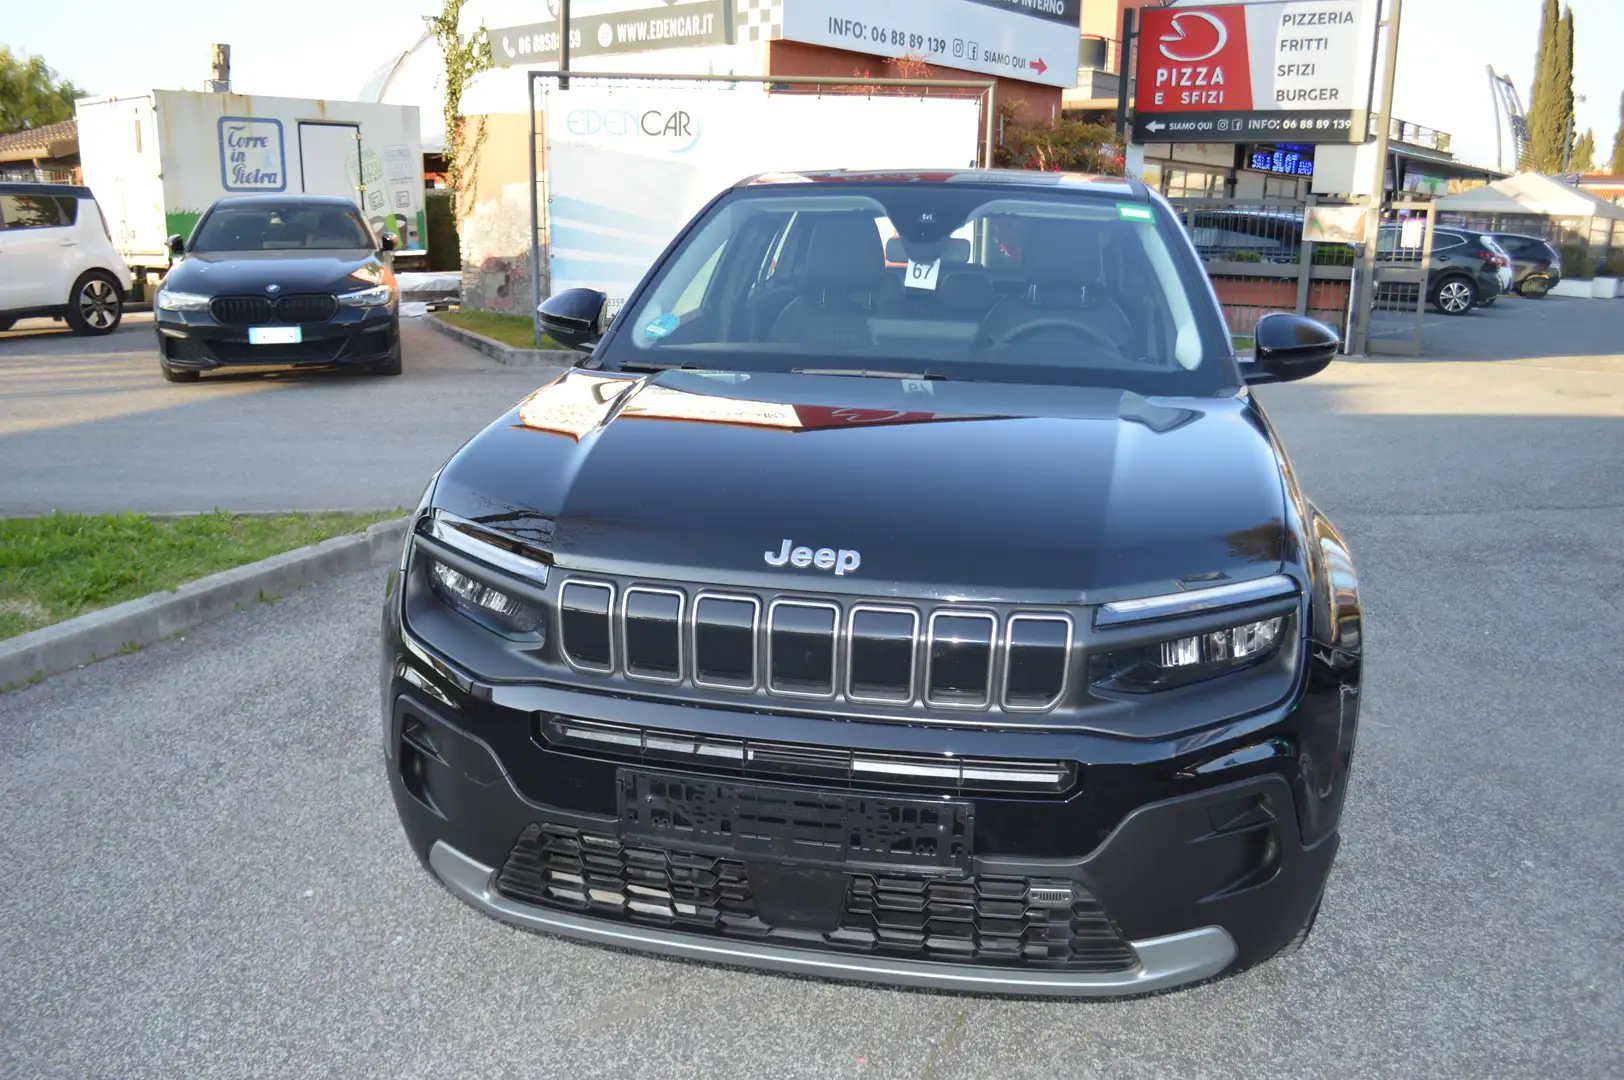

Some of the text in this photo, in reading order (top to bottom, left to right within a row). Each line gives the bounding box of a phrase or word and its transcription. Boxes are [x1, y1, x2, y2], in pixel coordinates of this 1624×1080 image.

[1282, 11, 1354, 27] PIZZERIA
[616, 13, 715, 43] WWW.EDENCAR.IT
[828, 17, 947, 54] INFO: 06 88 89 139
[1280, 38, 1328, 52] FRITTI
[983, 50, 1026, 70] SIAMO QUI
[1155, 66, 1225, 87] PIZZA
[1277, 64, 1315, 77] SFIZI
[1154, 91, 1224, 105] E SFIZI
[1276, 88, 1339, 102] BURGER
[566, 109, 692, 137] EDENCAR
[1169, 121, 1213, 132] SIAMO QUI
[1248, 118, 1352, 130] INFO: 06 88 89 139
[228, 126, 269, 148] Torre
[230, 148, 246, 163] in
[232, 163, 279, 184] Pietra
[912, 263, 935, 280] 67
[764, 538, 861, 576] Jeep
